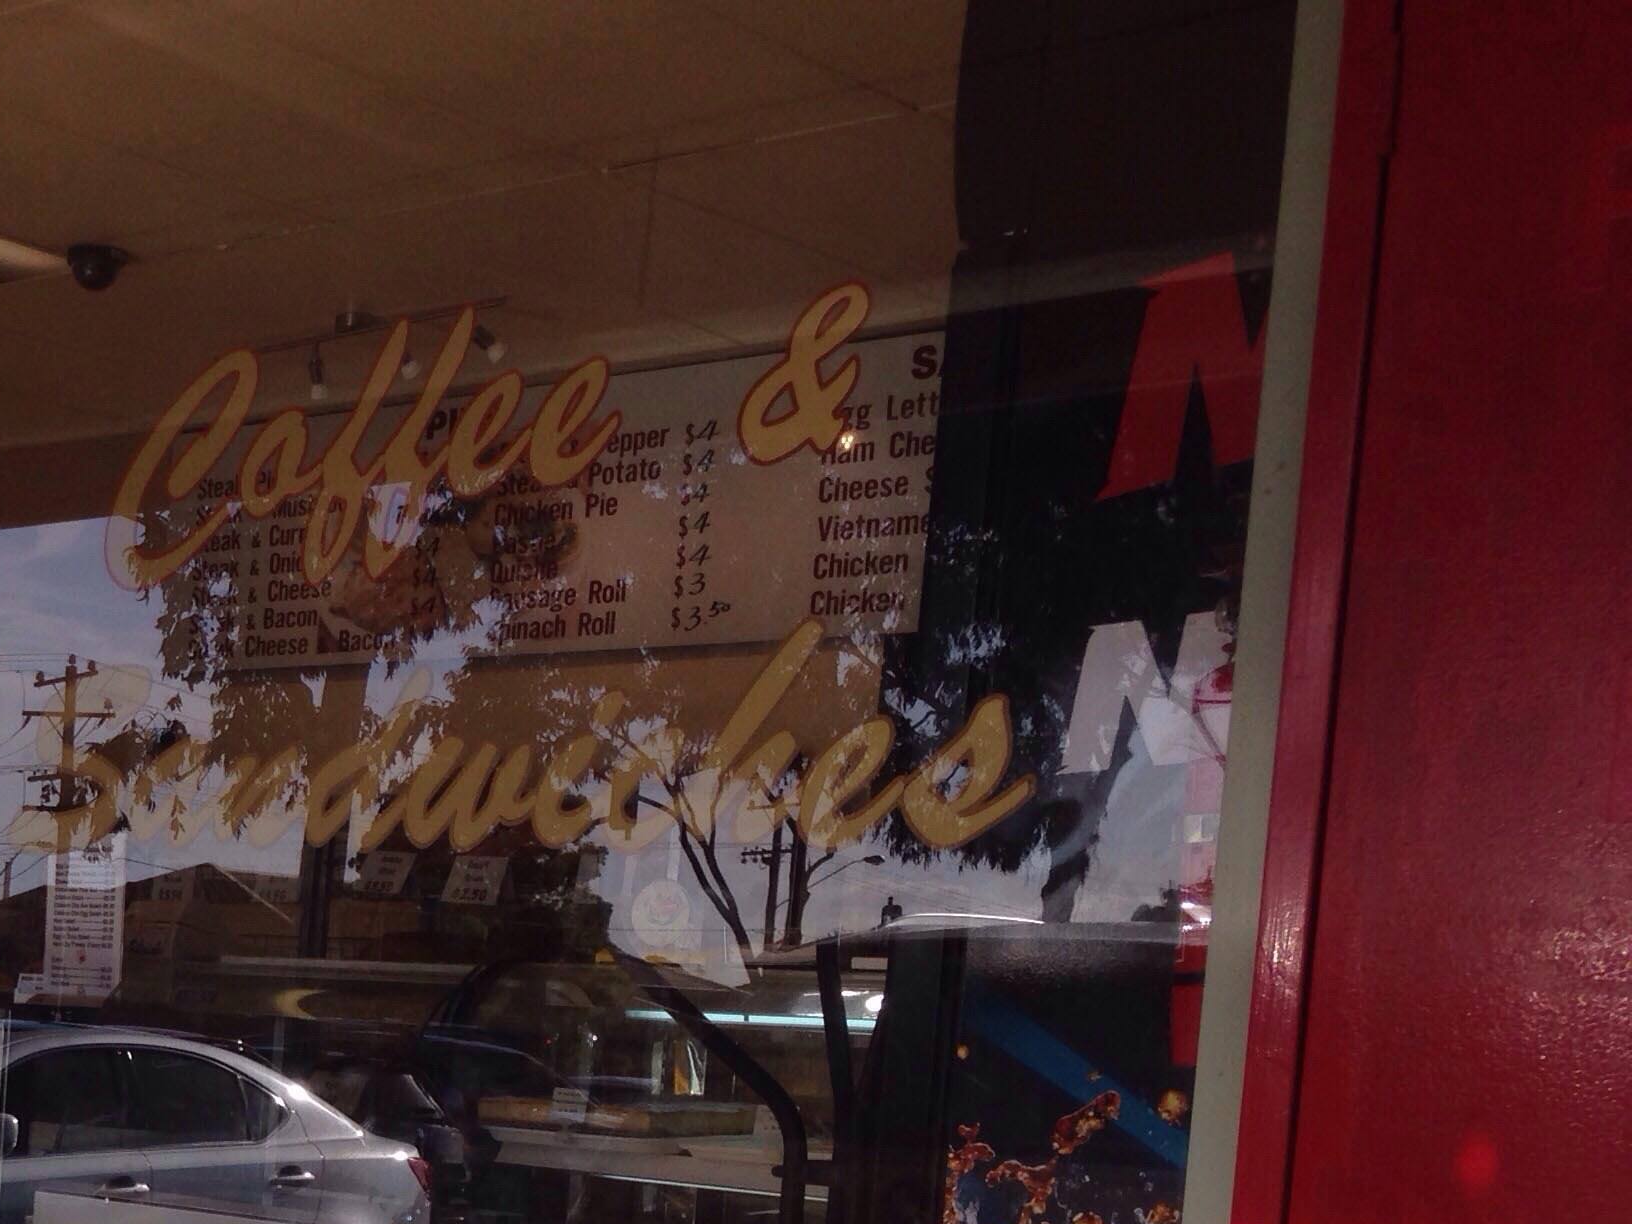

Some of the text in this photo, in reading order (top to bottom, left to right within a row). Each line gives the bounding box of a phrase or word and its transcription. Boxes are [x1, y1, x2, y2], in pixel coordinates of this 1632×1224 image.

[103, 283, 868, 591] Coffee &
[685, 419, 718, 446] $4
[588, 459, 661, 488] Potato
[681, 449, 714, 475] $4
[818, 475, 909, 504] Cheese
[585, 491, 618, 518] Pie
[678, 510, 711, 538] $4
[675, 543, 712, 570] $4
[813, 551, 908, 580] Chicken
[268, 579, 332, 602] Cheese
[588, 577, 626, 605] Roll
[673, 573, 707, 599] $3
[809, 590, 906, 617] Chicken
[263, 607, 318, 631] Bacon
[577, 610, 617, 638] Roll
[244, 634, 308, 658] Cheese
